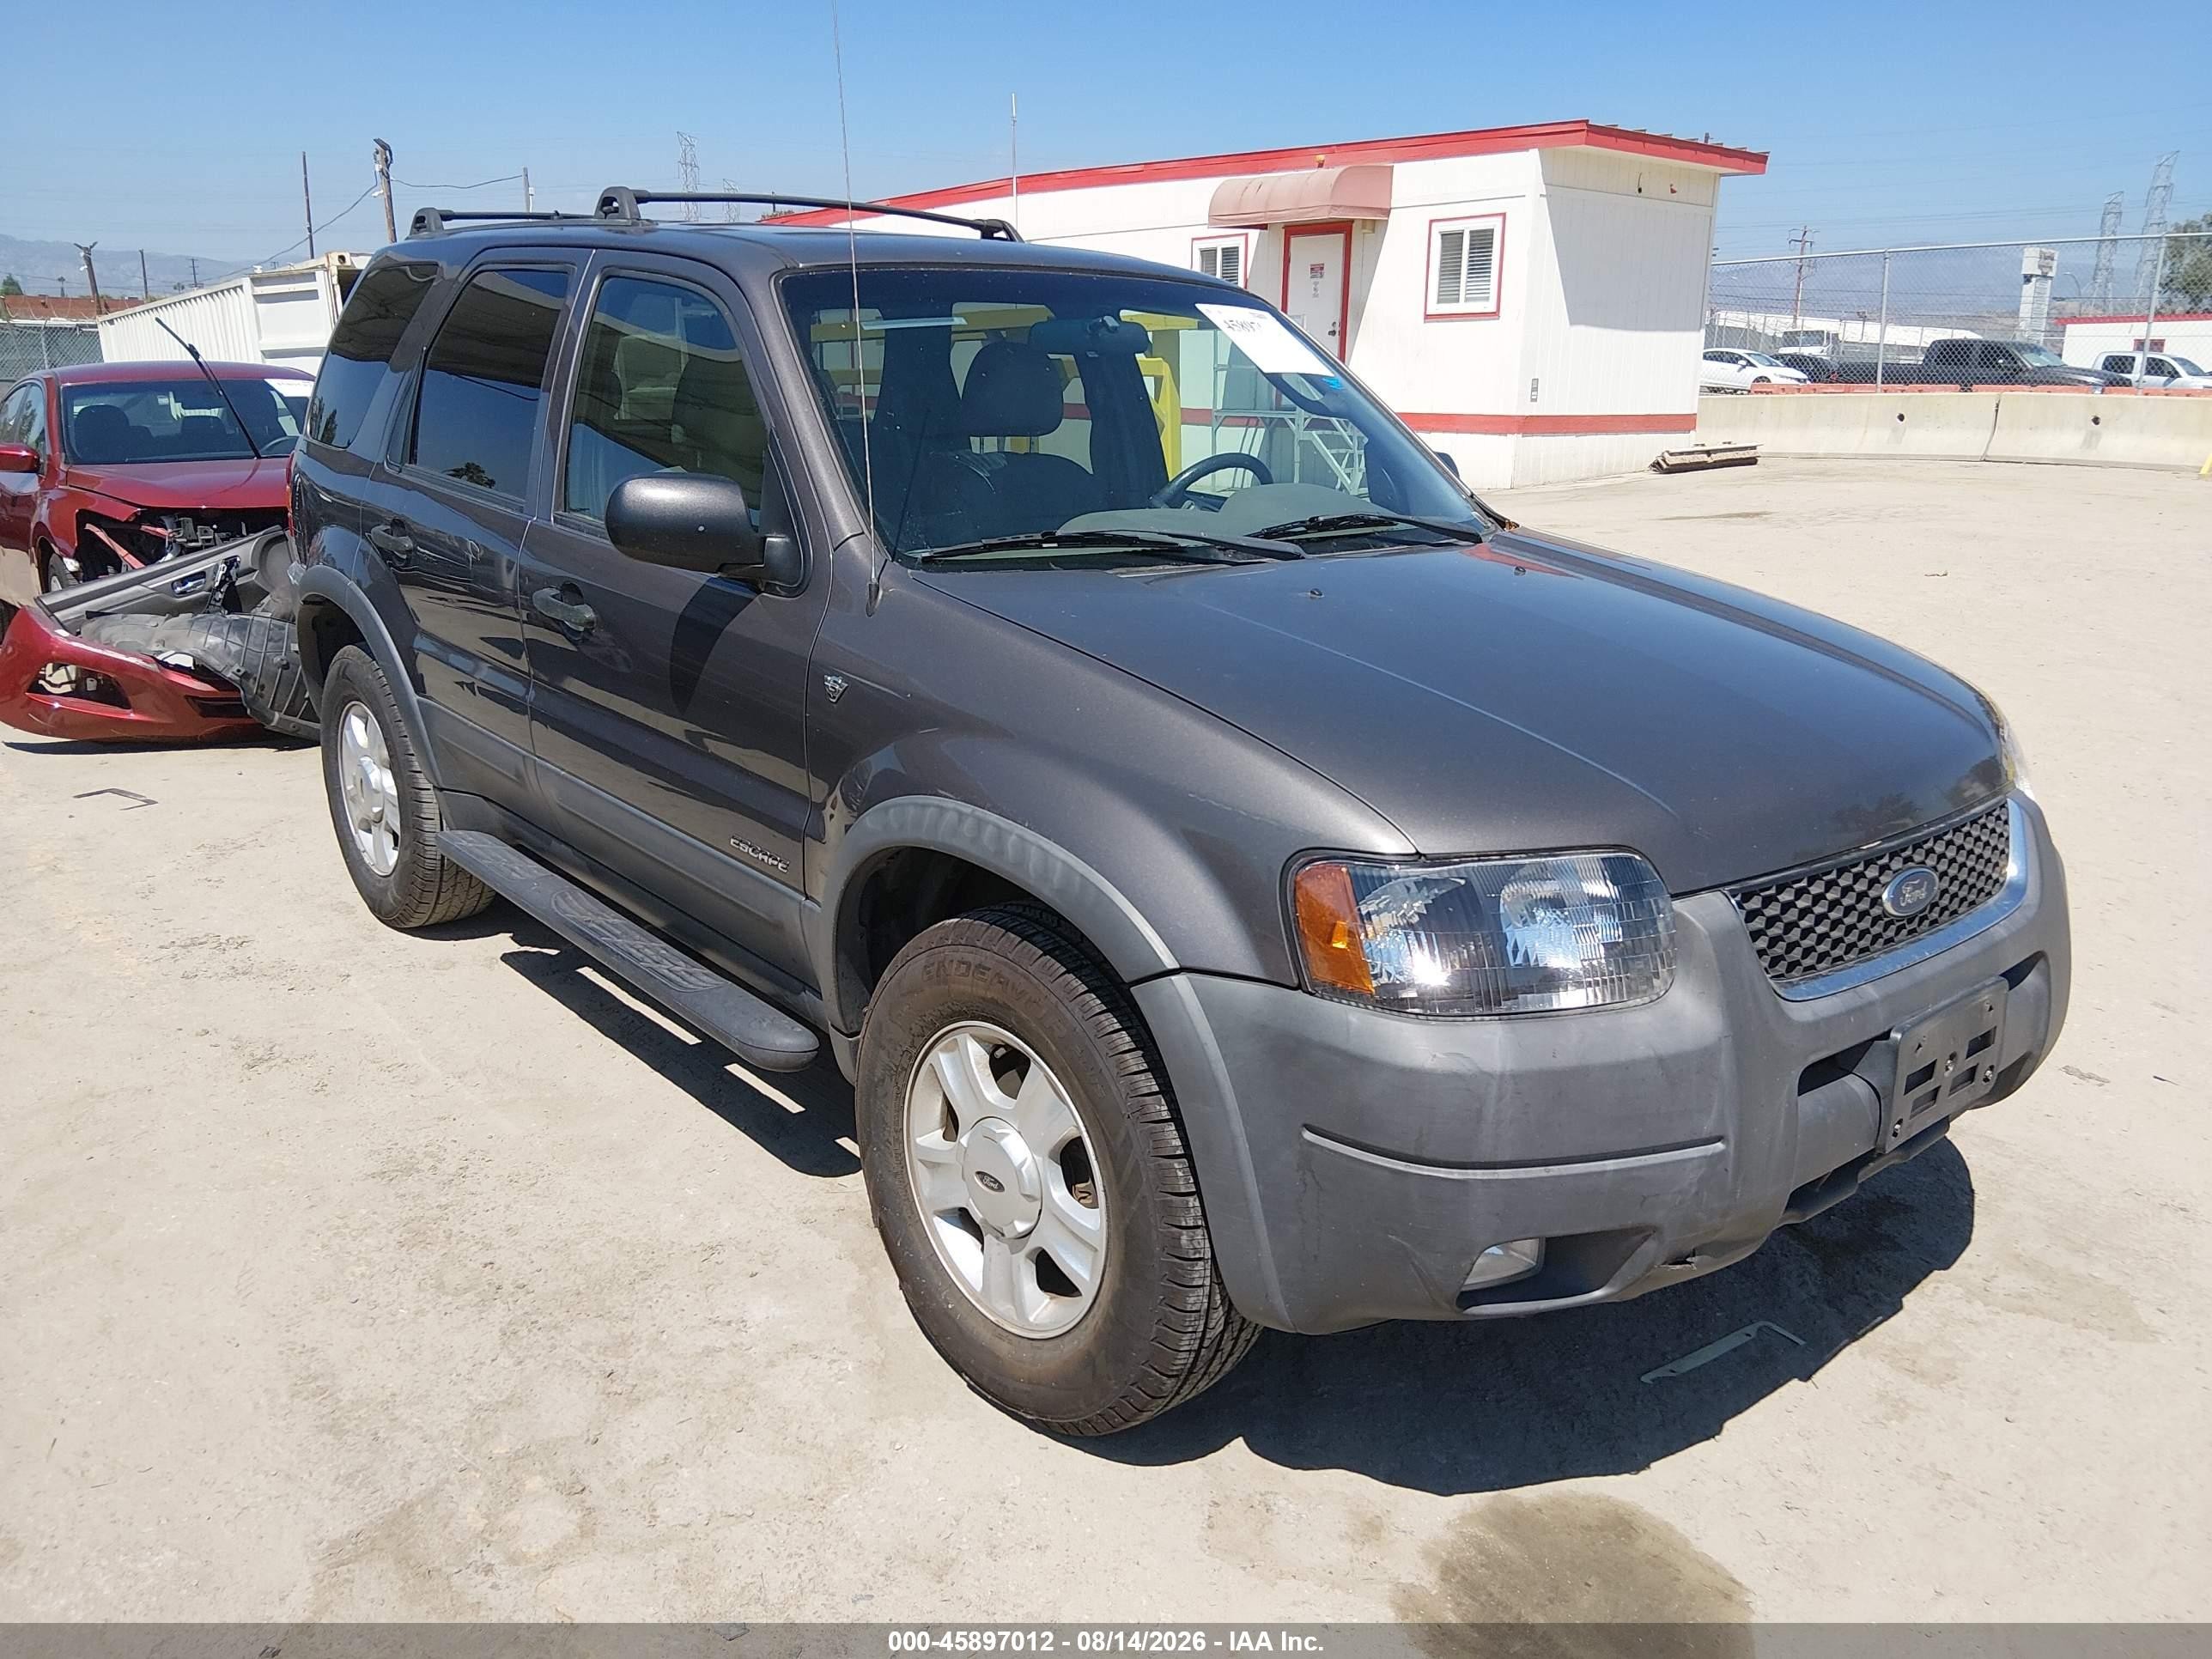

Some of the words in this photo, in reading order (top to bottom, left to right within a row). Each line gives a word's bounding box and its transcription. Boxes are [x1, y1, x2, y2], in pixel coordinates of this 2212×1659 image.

[730, 836, 790, 873] ESCAPE
[1899, 878, 1928, 907] Ford
[982, 1175, 999, 1190] Ford
